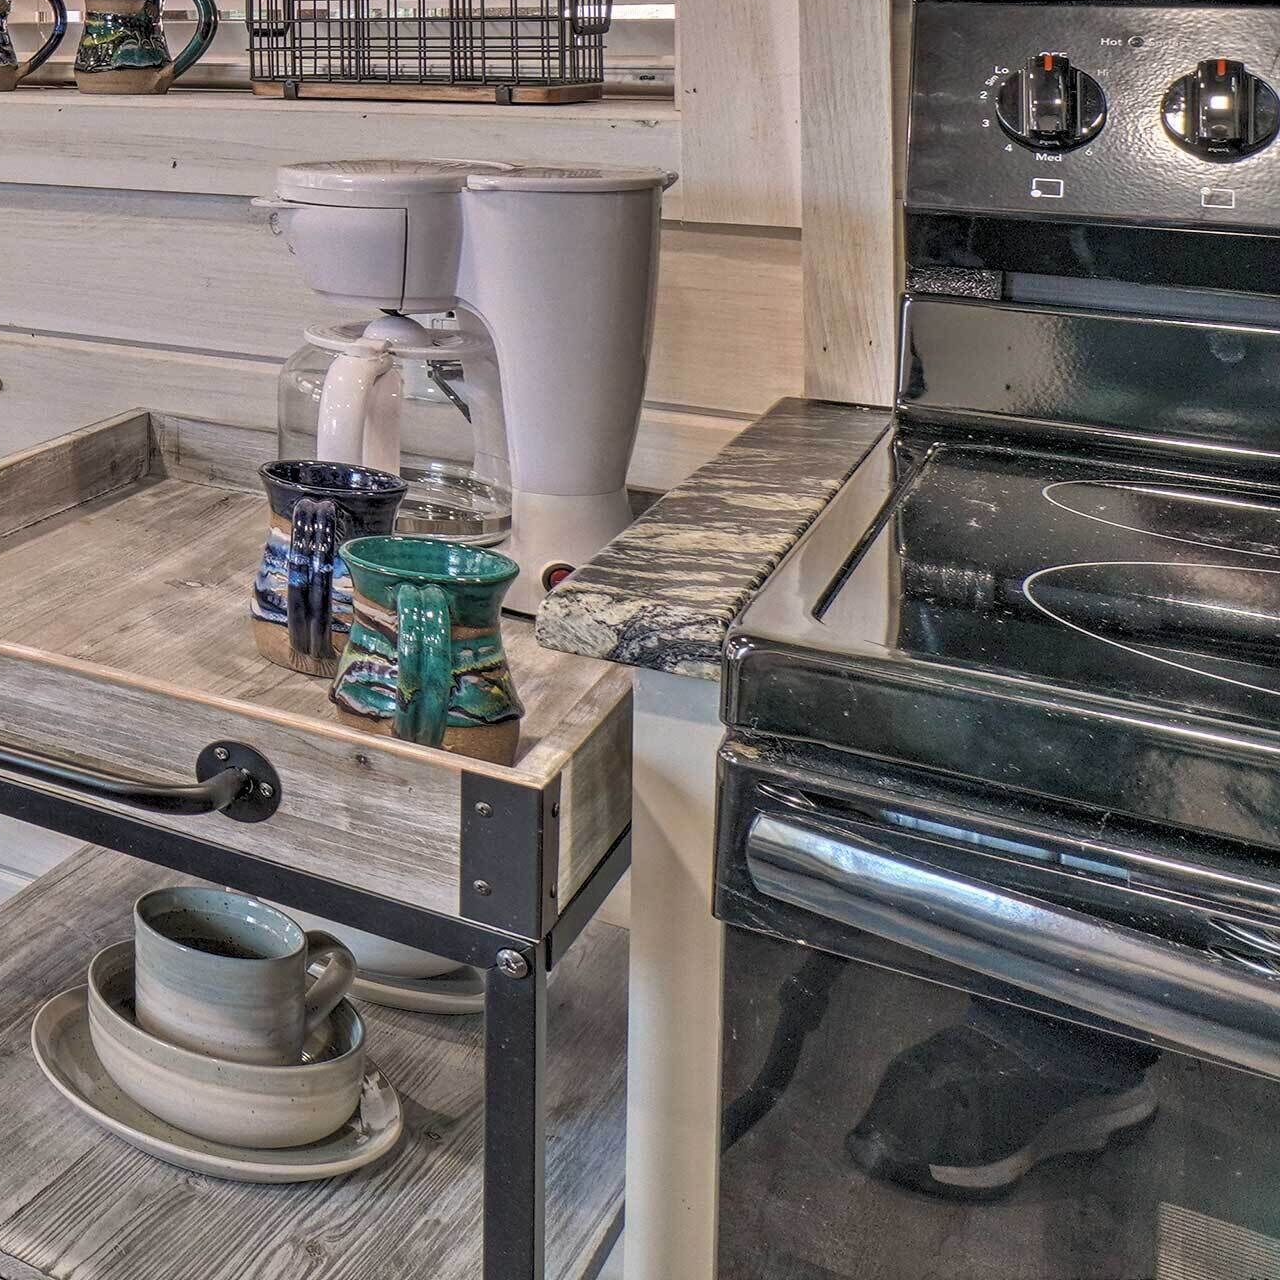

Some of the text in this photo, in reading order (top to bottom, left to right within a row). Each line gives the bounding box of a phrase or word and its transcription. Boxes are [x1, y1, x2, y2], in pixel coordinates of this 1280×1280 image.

[1100, 37, 1123, 47] Hot
[994, 66, 1010, 74] Lo
[979, 91, 988, 100] 2
[981, 119, 990, 128] 3
[1004, 143, 1013, 152] 4
[1085, 147, 1093, 156] 6
[1035, 152, 1063, 163] Med
